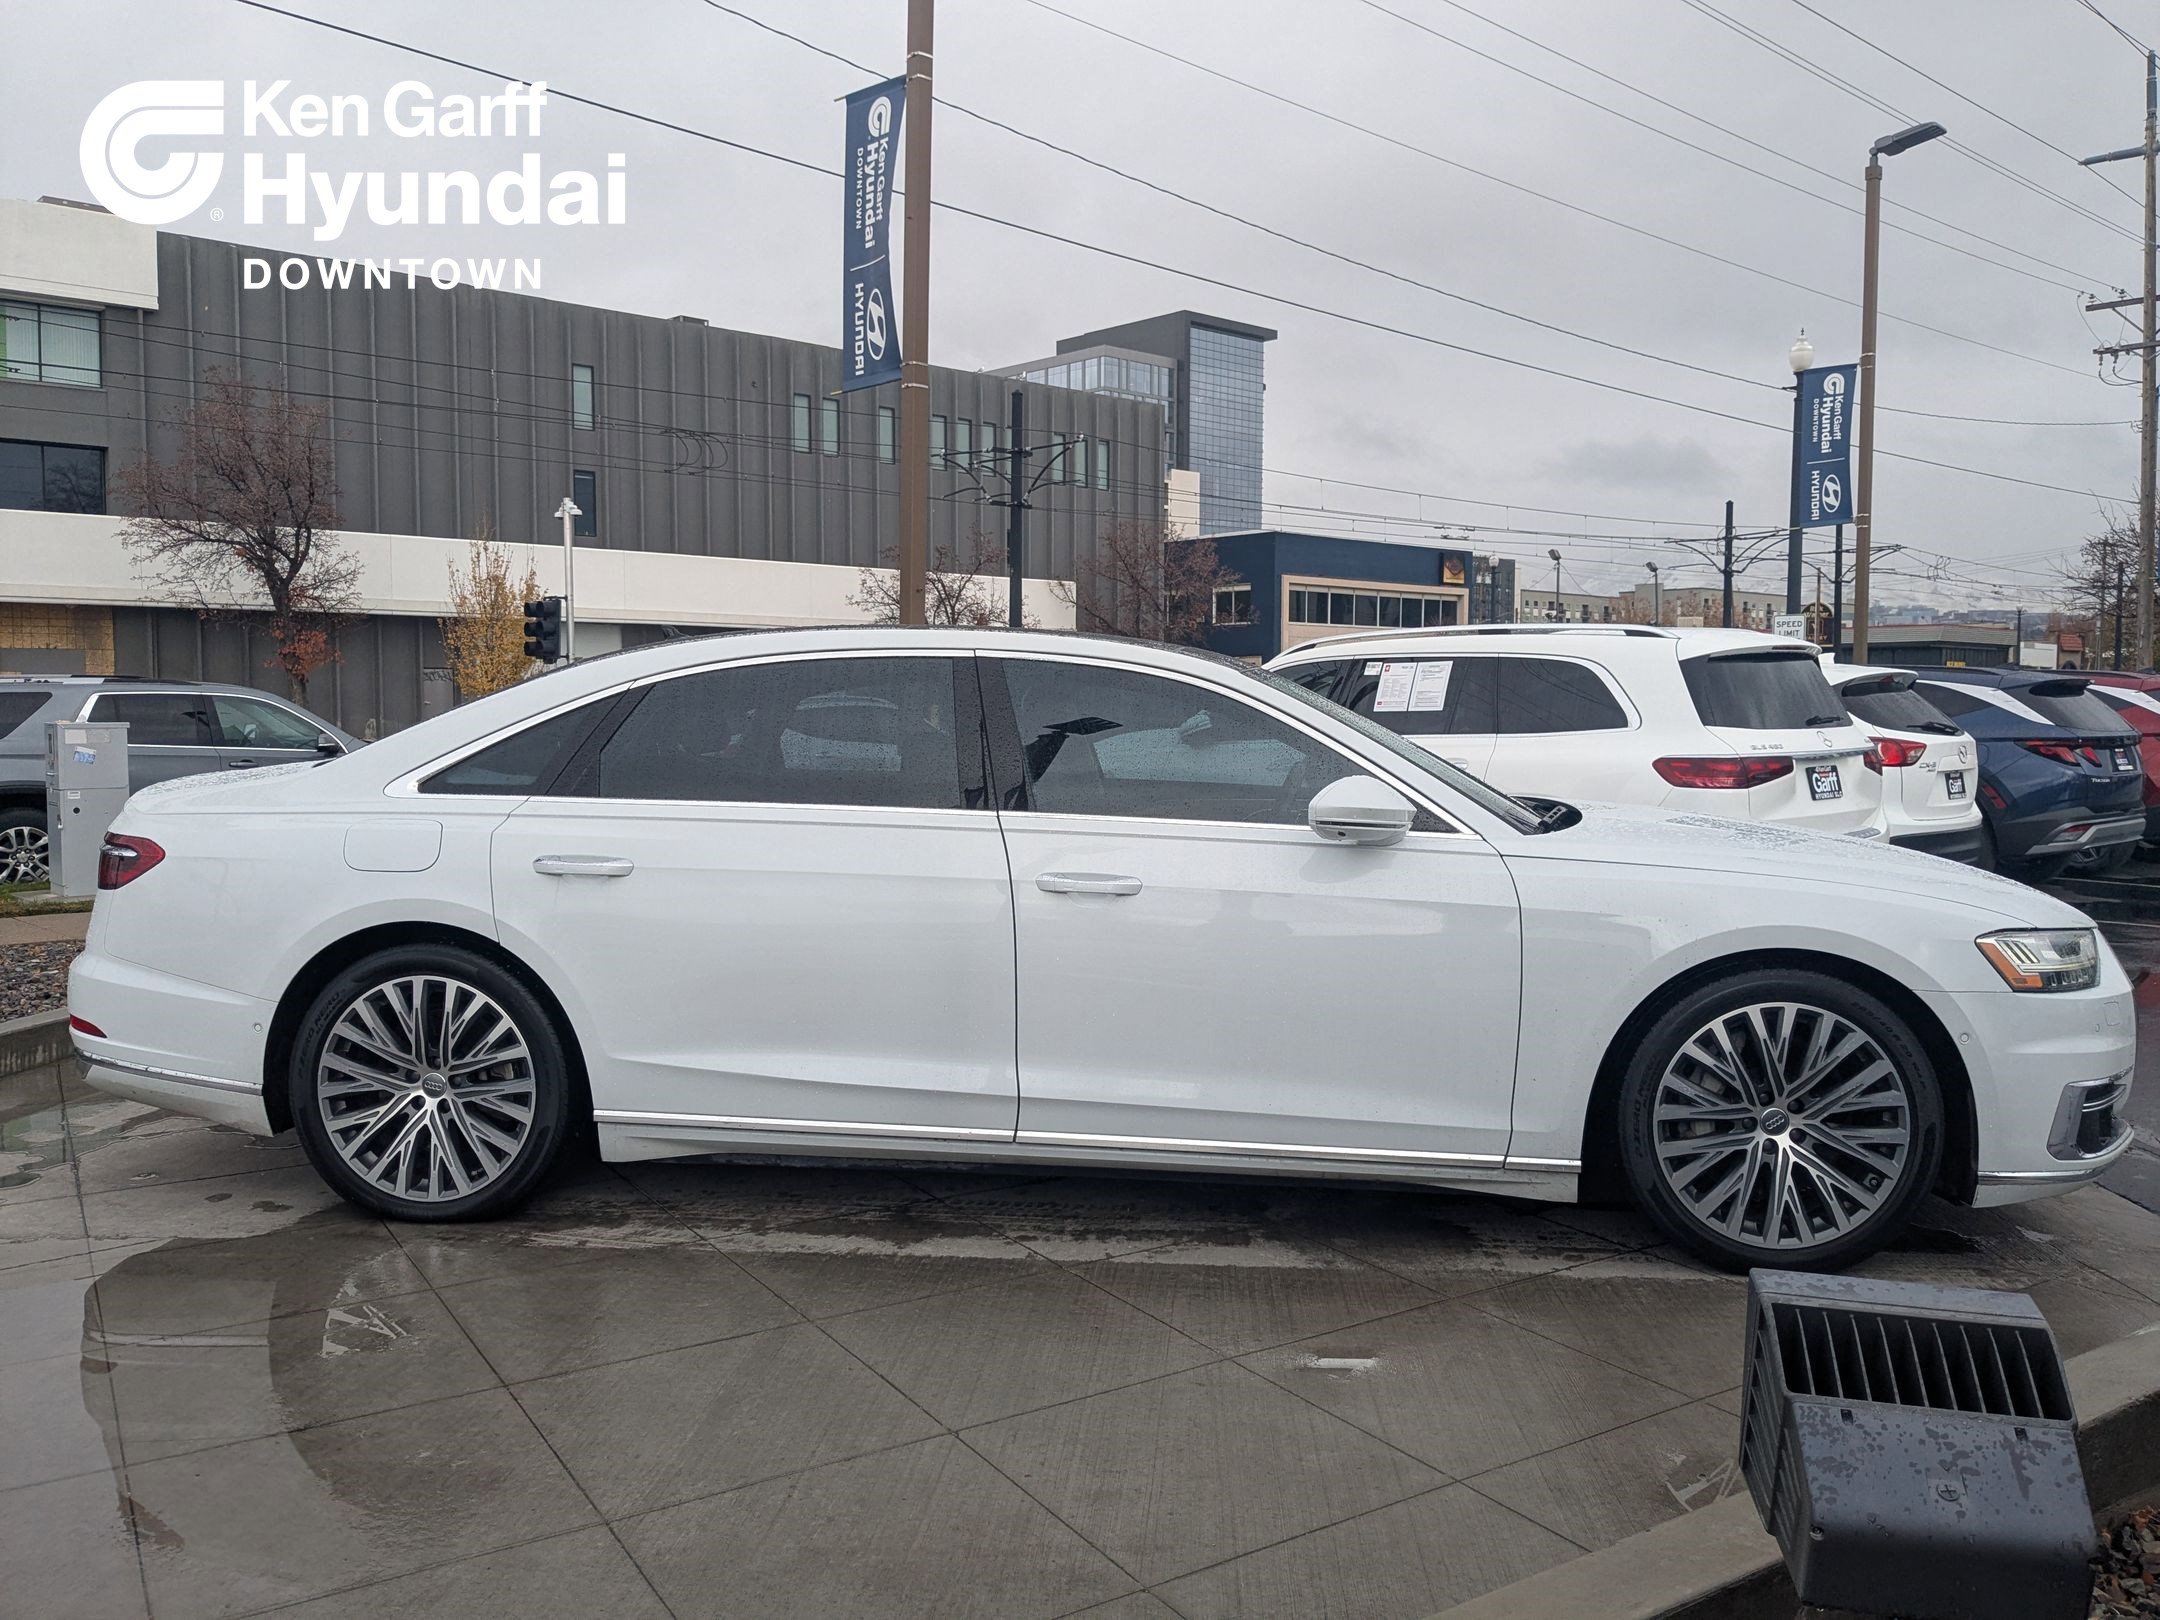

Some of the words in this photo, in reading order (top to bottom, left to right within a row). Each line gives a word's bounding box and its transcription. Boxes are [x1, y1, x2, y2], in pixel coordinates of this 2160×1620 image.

[877, 136, 889, 177] Ken
[855, 147, 863, 229] DOWNTOWN
[865, 141, 876, 249] Hyundai
[876, 177, 886, 221] Garff
[855, 282, 864, 376] HYUNDAI
[1812, 398, 1820, 443] DOWNTOWN
[1821, 397, 1834, 454] Hyundai
[1834, 395, 1844, 417] Ken
[1833, 417, 1843, 440] Garff
[1811, 470, 1820, 521] HYUNDAI
[1776, 620, 1802, 628] SPEED
[1778, 629, 1800, 637] LIMIT
[1812, 772, 1839, 793] Garff
